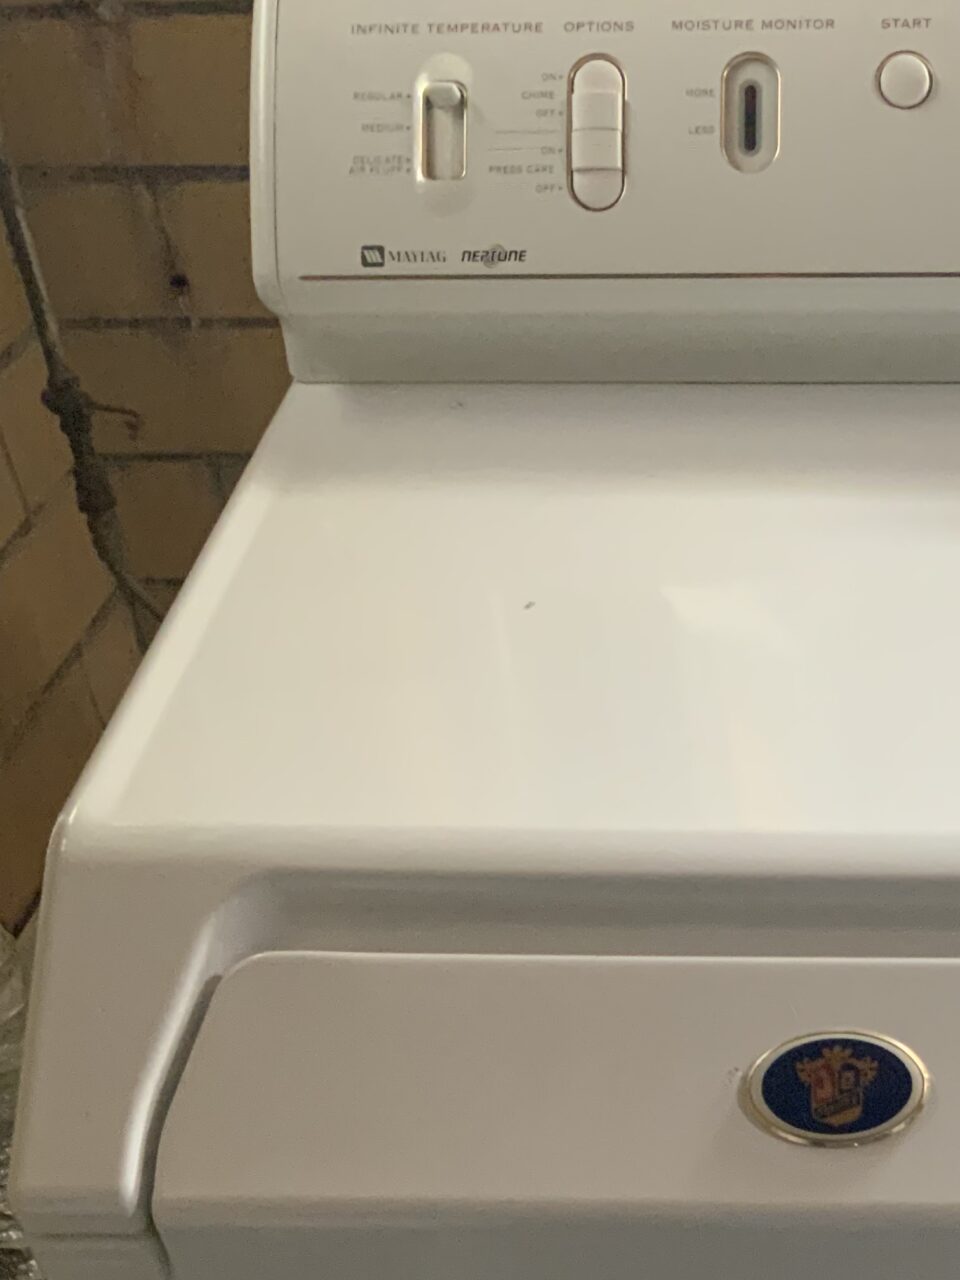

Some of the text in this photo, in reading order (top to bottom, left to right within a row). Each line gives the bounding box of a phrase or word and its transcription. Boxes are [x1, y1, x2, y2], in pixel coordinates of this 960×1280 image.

[351, 22, 544, 34] INFINITE TEMPERATURE
[563, 20, 635, 33] OPTIONS
[671, 19, 835, 31] MOISTURE MONITOR
[881, 18, 932, 30] START
[353, 91, 403, 101] REGULAR
[521, 90, 555, 100] CHIME
[686, 88, 716, 98] MORE
[488, 164, 523, 175] PRESS
[387, 250, 447, 264] MAYTAG
